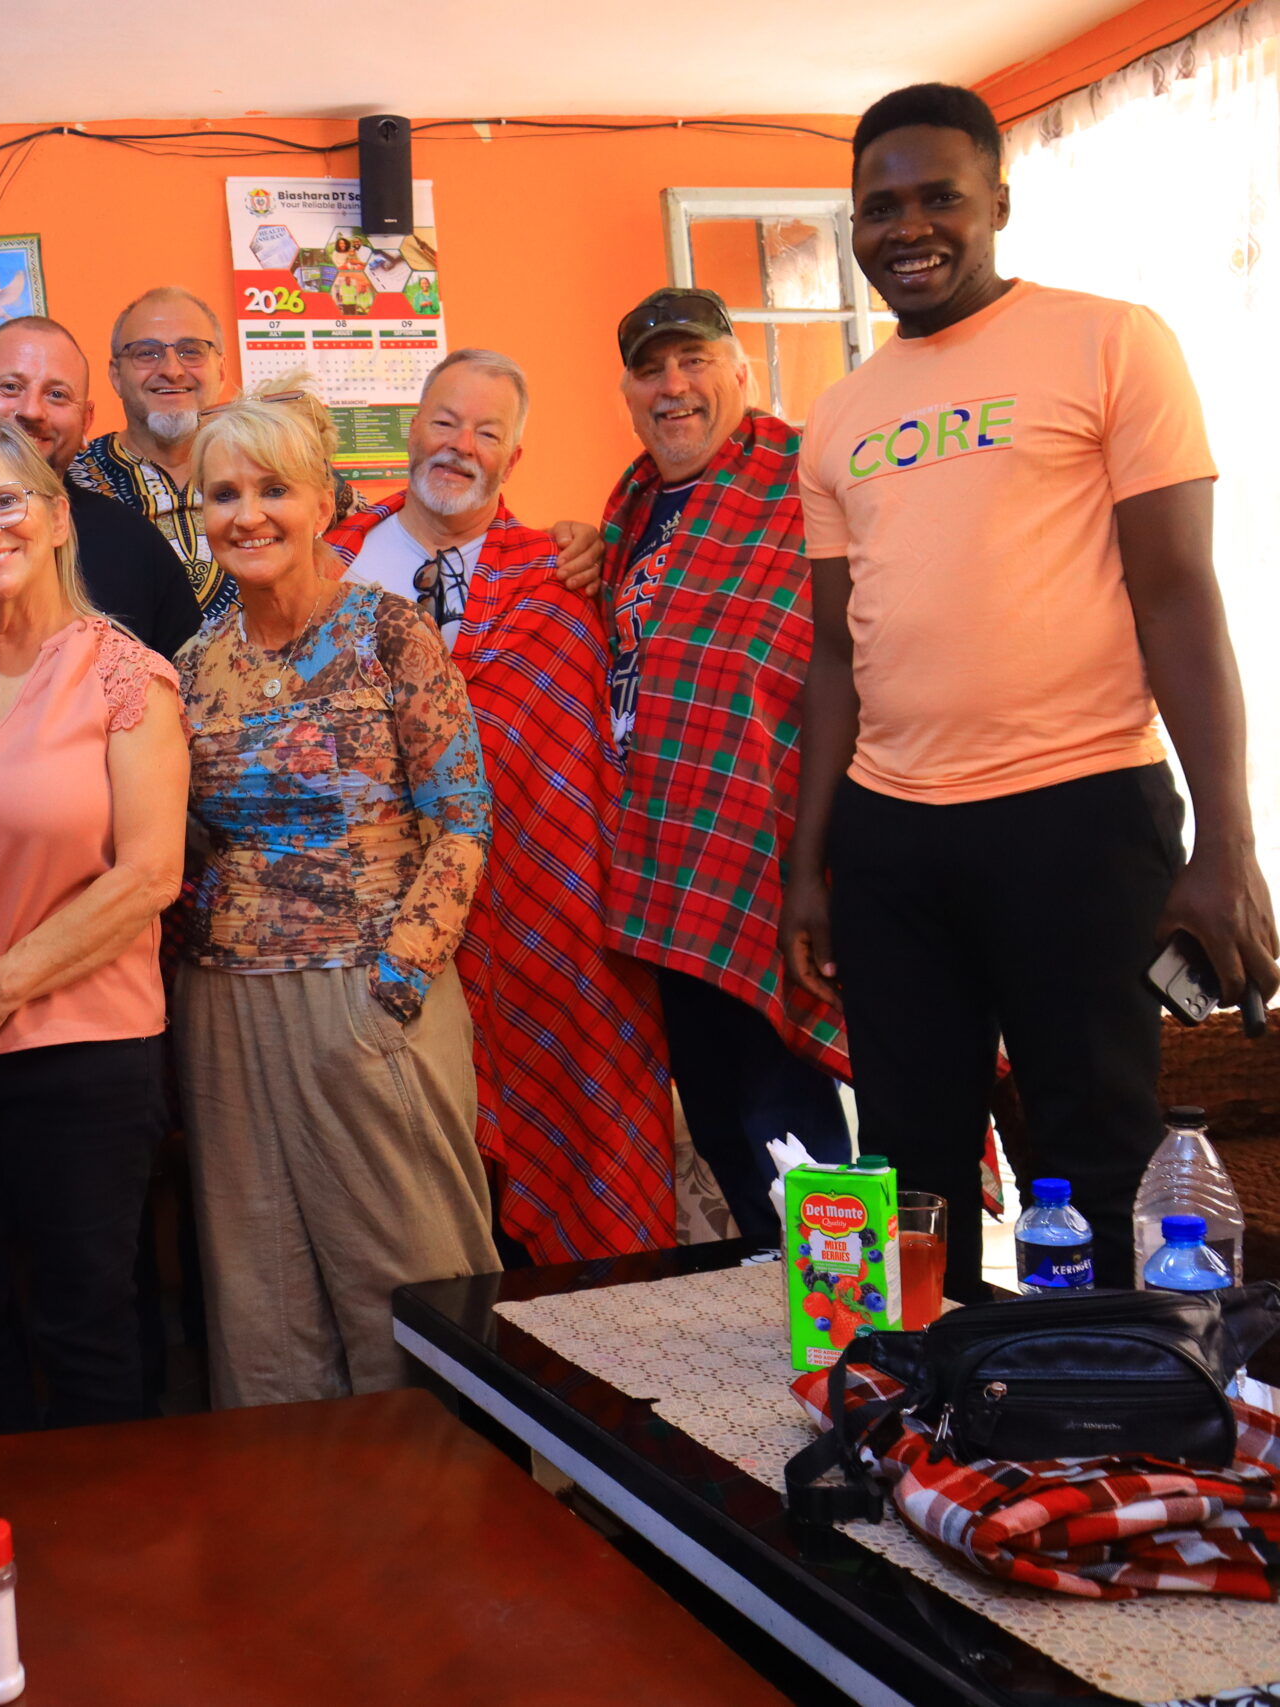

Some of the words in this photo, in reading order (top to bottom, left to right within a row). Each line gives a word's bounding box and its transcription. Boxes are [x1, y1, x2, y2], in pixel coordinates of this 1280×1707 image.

[278, 190, 330, 200] Biashara
[332, 192, 346, 200] DT
[244, 286, 305, 314] 2026
[269, 321, 280, 329] 07
[401, 320, 413, 328] 09
[849, 399, 1016, 478] CORE
[805, 1204, 824, 1216] Del
[826, 1205, 864, 1220] Monte
[821, 1217, 847, 1228] Quality
[824, 1240, 847, 1251] MIXED
[821, 1250, 850, 1262] BERRIES
